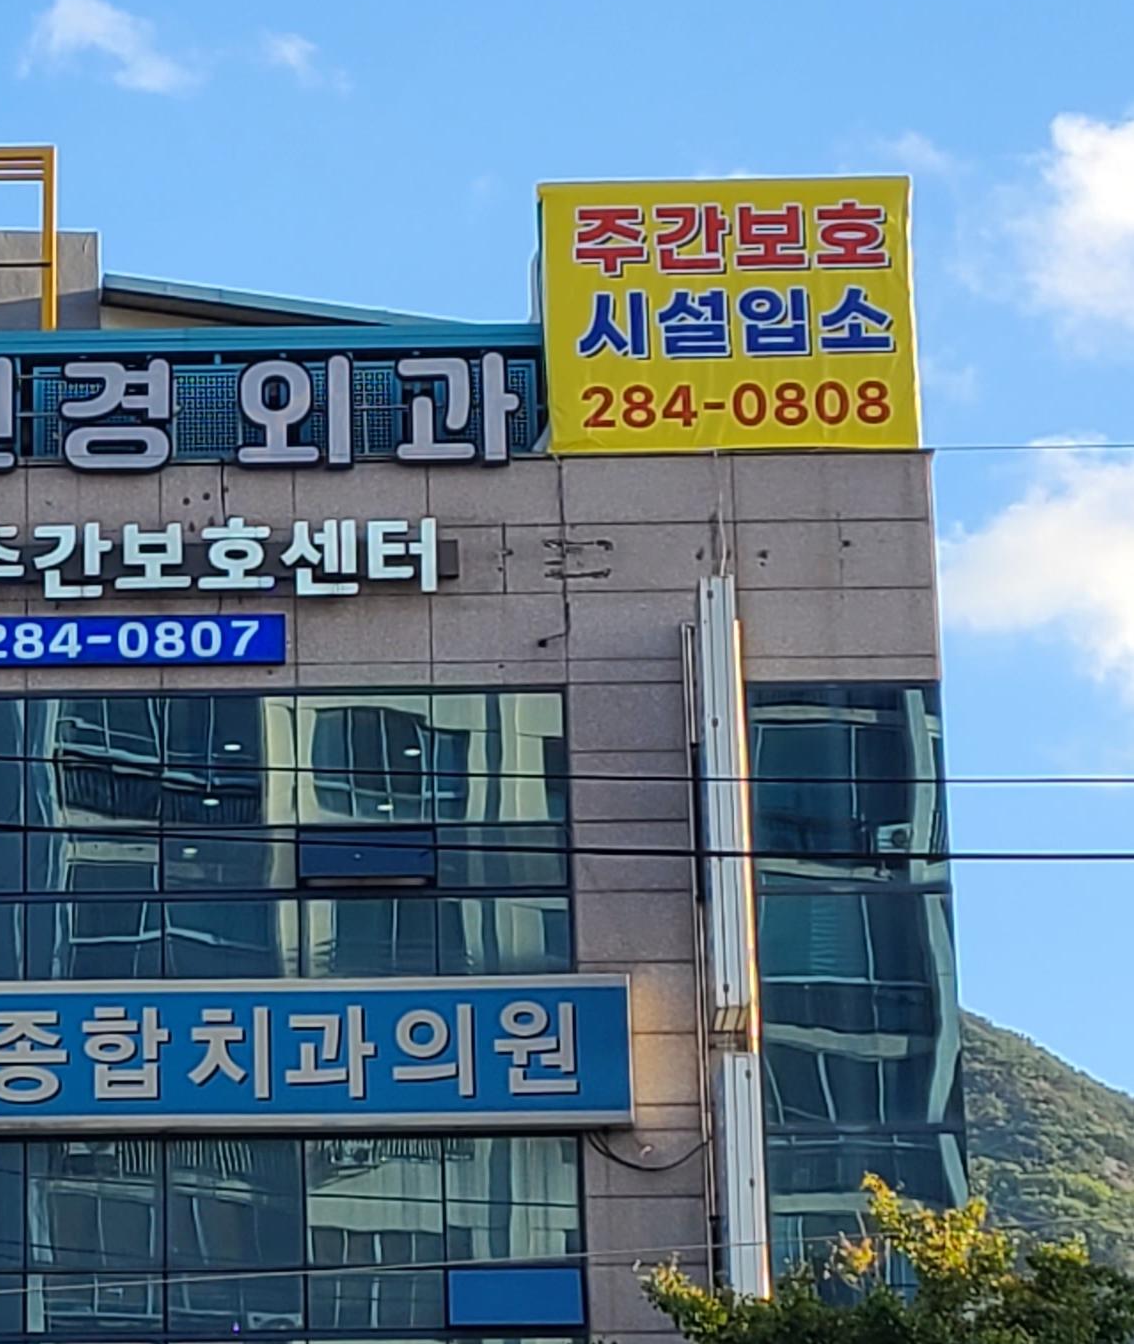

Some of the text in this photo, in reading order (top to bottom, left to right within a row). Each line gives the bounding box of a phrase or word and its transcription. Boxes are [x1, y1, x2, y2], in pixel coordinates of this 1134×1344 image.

[574, 200, 894, 277] 주간보호
[577, 286, 897, 360] 시설입소
[581, 378, 894, 430] 284-0808
